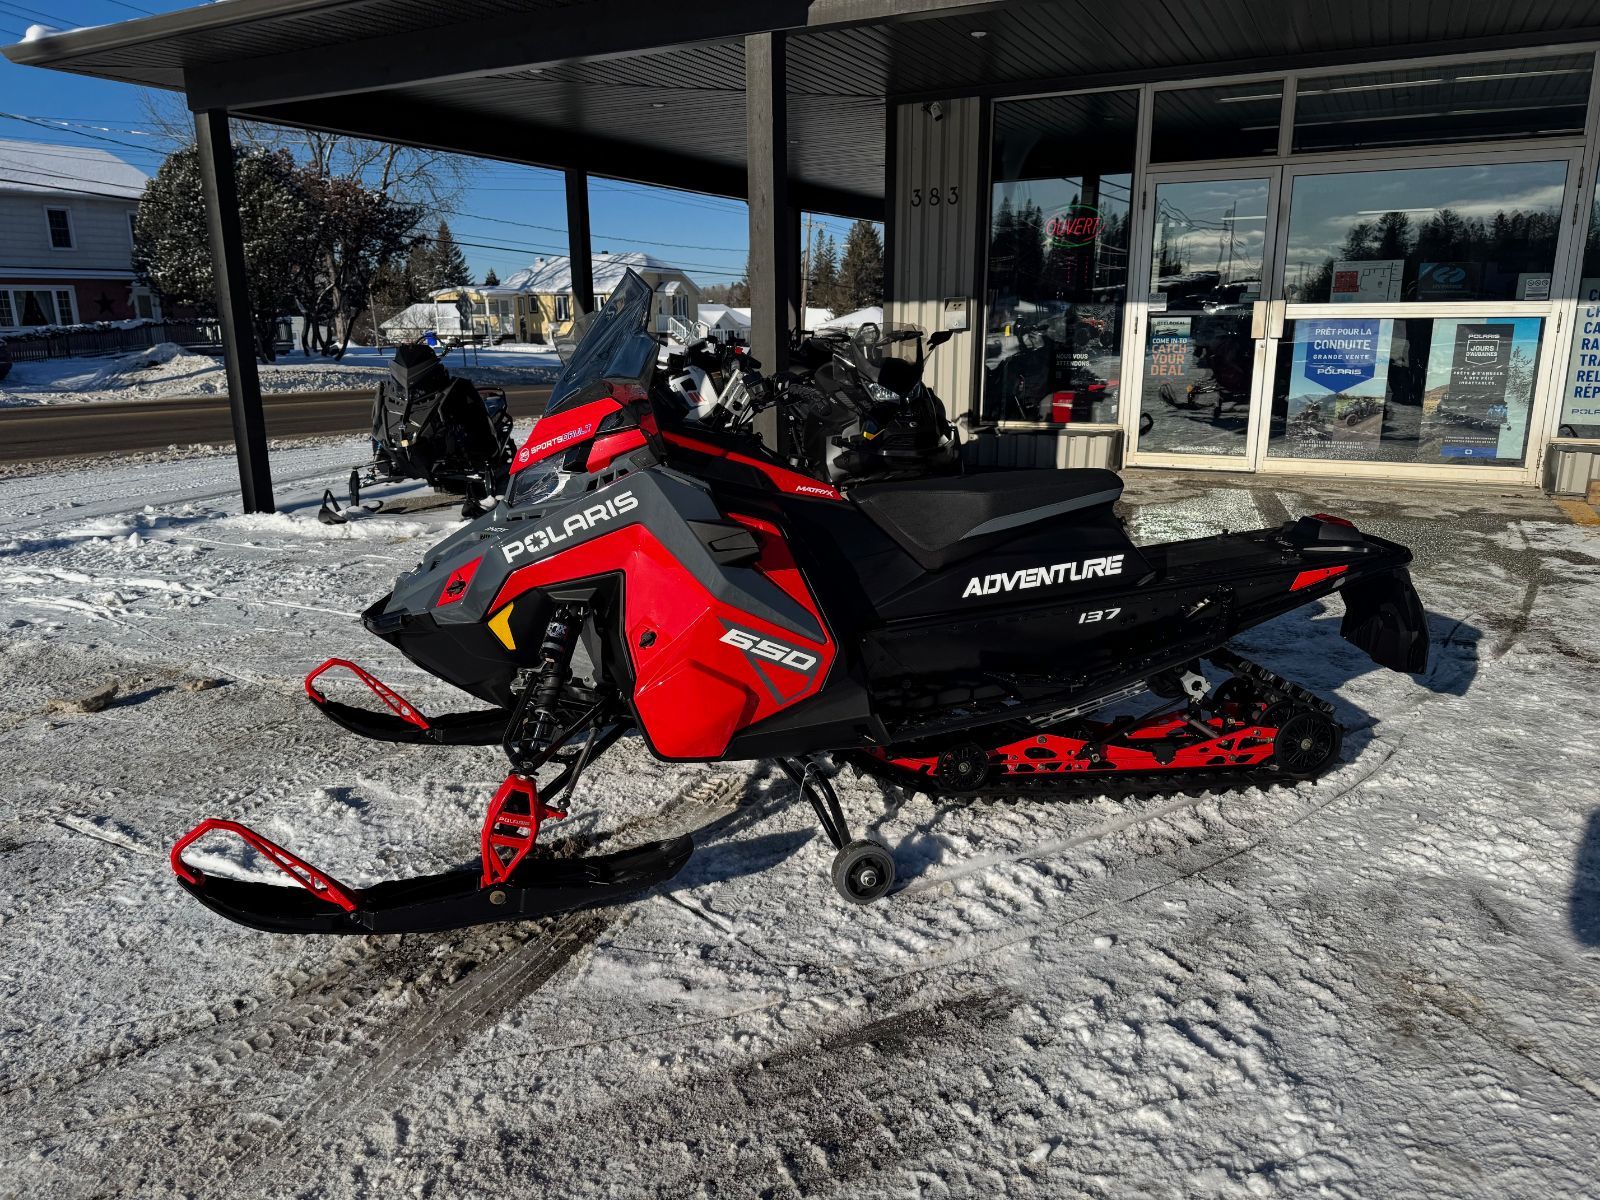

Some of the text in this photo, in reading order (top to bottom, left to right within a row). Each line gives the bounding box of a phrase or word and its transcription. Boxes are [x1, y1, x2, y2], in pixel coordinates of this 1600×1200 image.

[911, 186, 959, 207] 383
[1046, 217, 1102, 236] OUVERT
[1315, 327, 1372, 336] PRÊT POUR LA
[1151, 343, 1187, 354] CATCH
[1314, 339, 1371, 350] CONDUITE
[1152, 353, 1185, 364] YOUR
[1150, 364, 1185, 376] DEAL
[1317, 367, 1362, 375] POLARIS
[795, 485, 834, 498] MATRYX
[501, 490, 639, 564] POLARIS
[961, 554, 1125, 598] ADVENTURE
[1078, 607, 1122, 624] 137
[719, 628, 817, 671] 650
